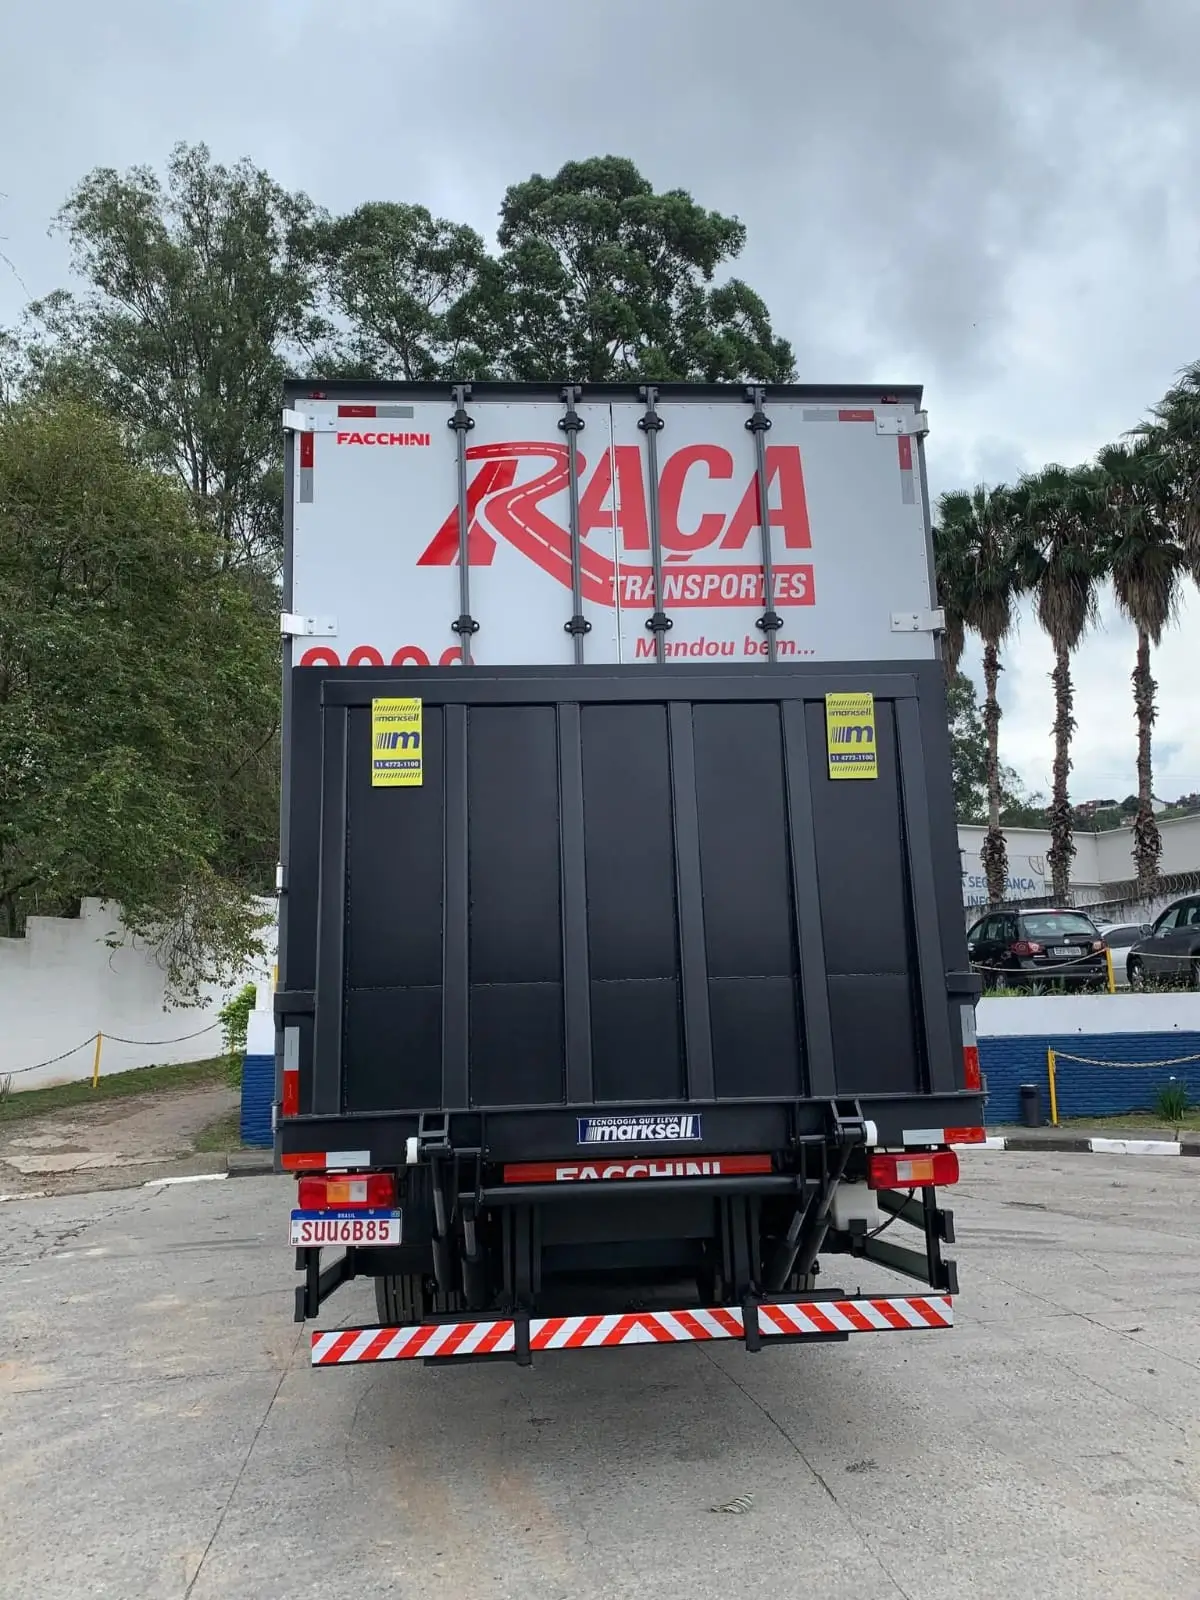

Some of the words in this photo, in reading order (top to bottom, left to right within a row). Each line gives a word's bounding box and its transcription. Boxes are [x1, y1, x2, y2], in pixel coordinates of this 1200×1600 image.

[337, 433, 430, 446] FACCHINI
[416, 441, 812, 566] RAÇA
[635, 637, 735, 657] Mandou
[968, 876, 1036, 892] SEANÇA
[588, 1118, 637, 1126] TECNOLOGIA
[639, 1117, 655, 1125] QUE
[657, 1116, 679, 1124] ELEVA
[301, 1220, 390, 1242] SUU6B85
